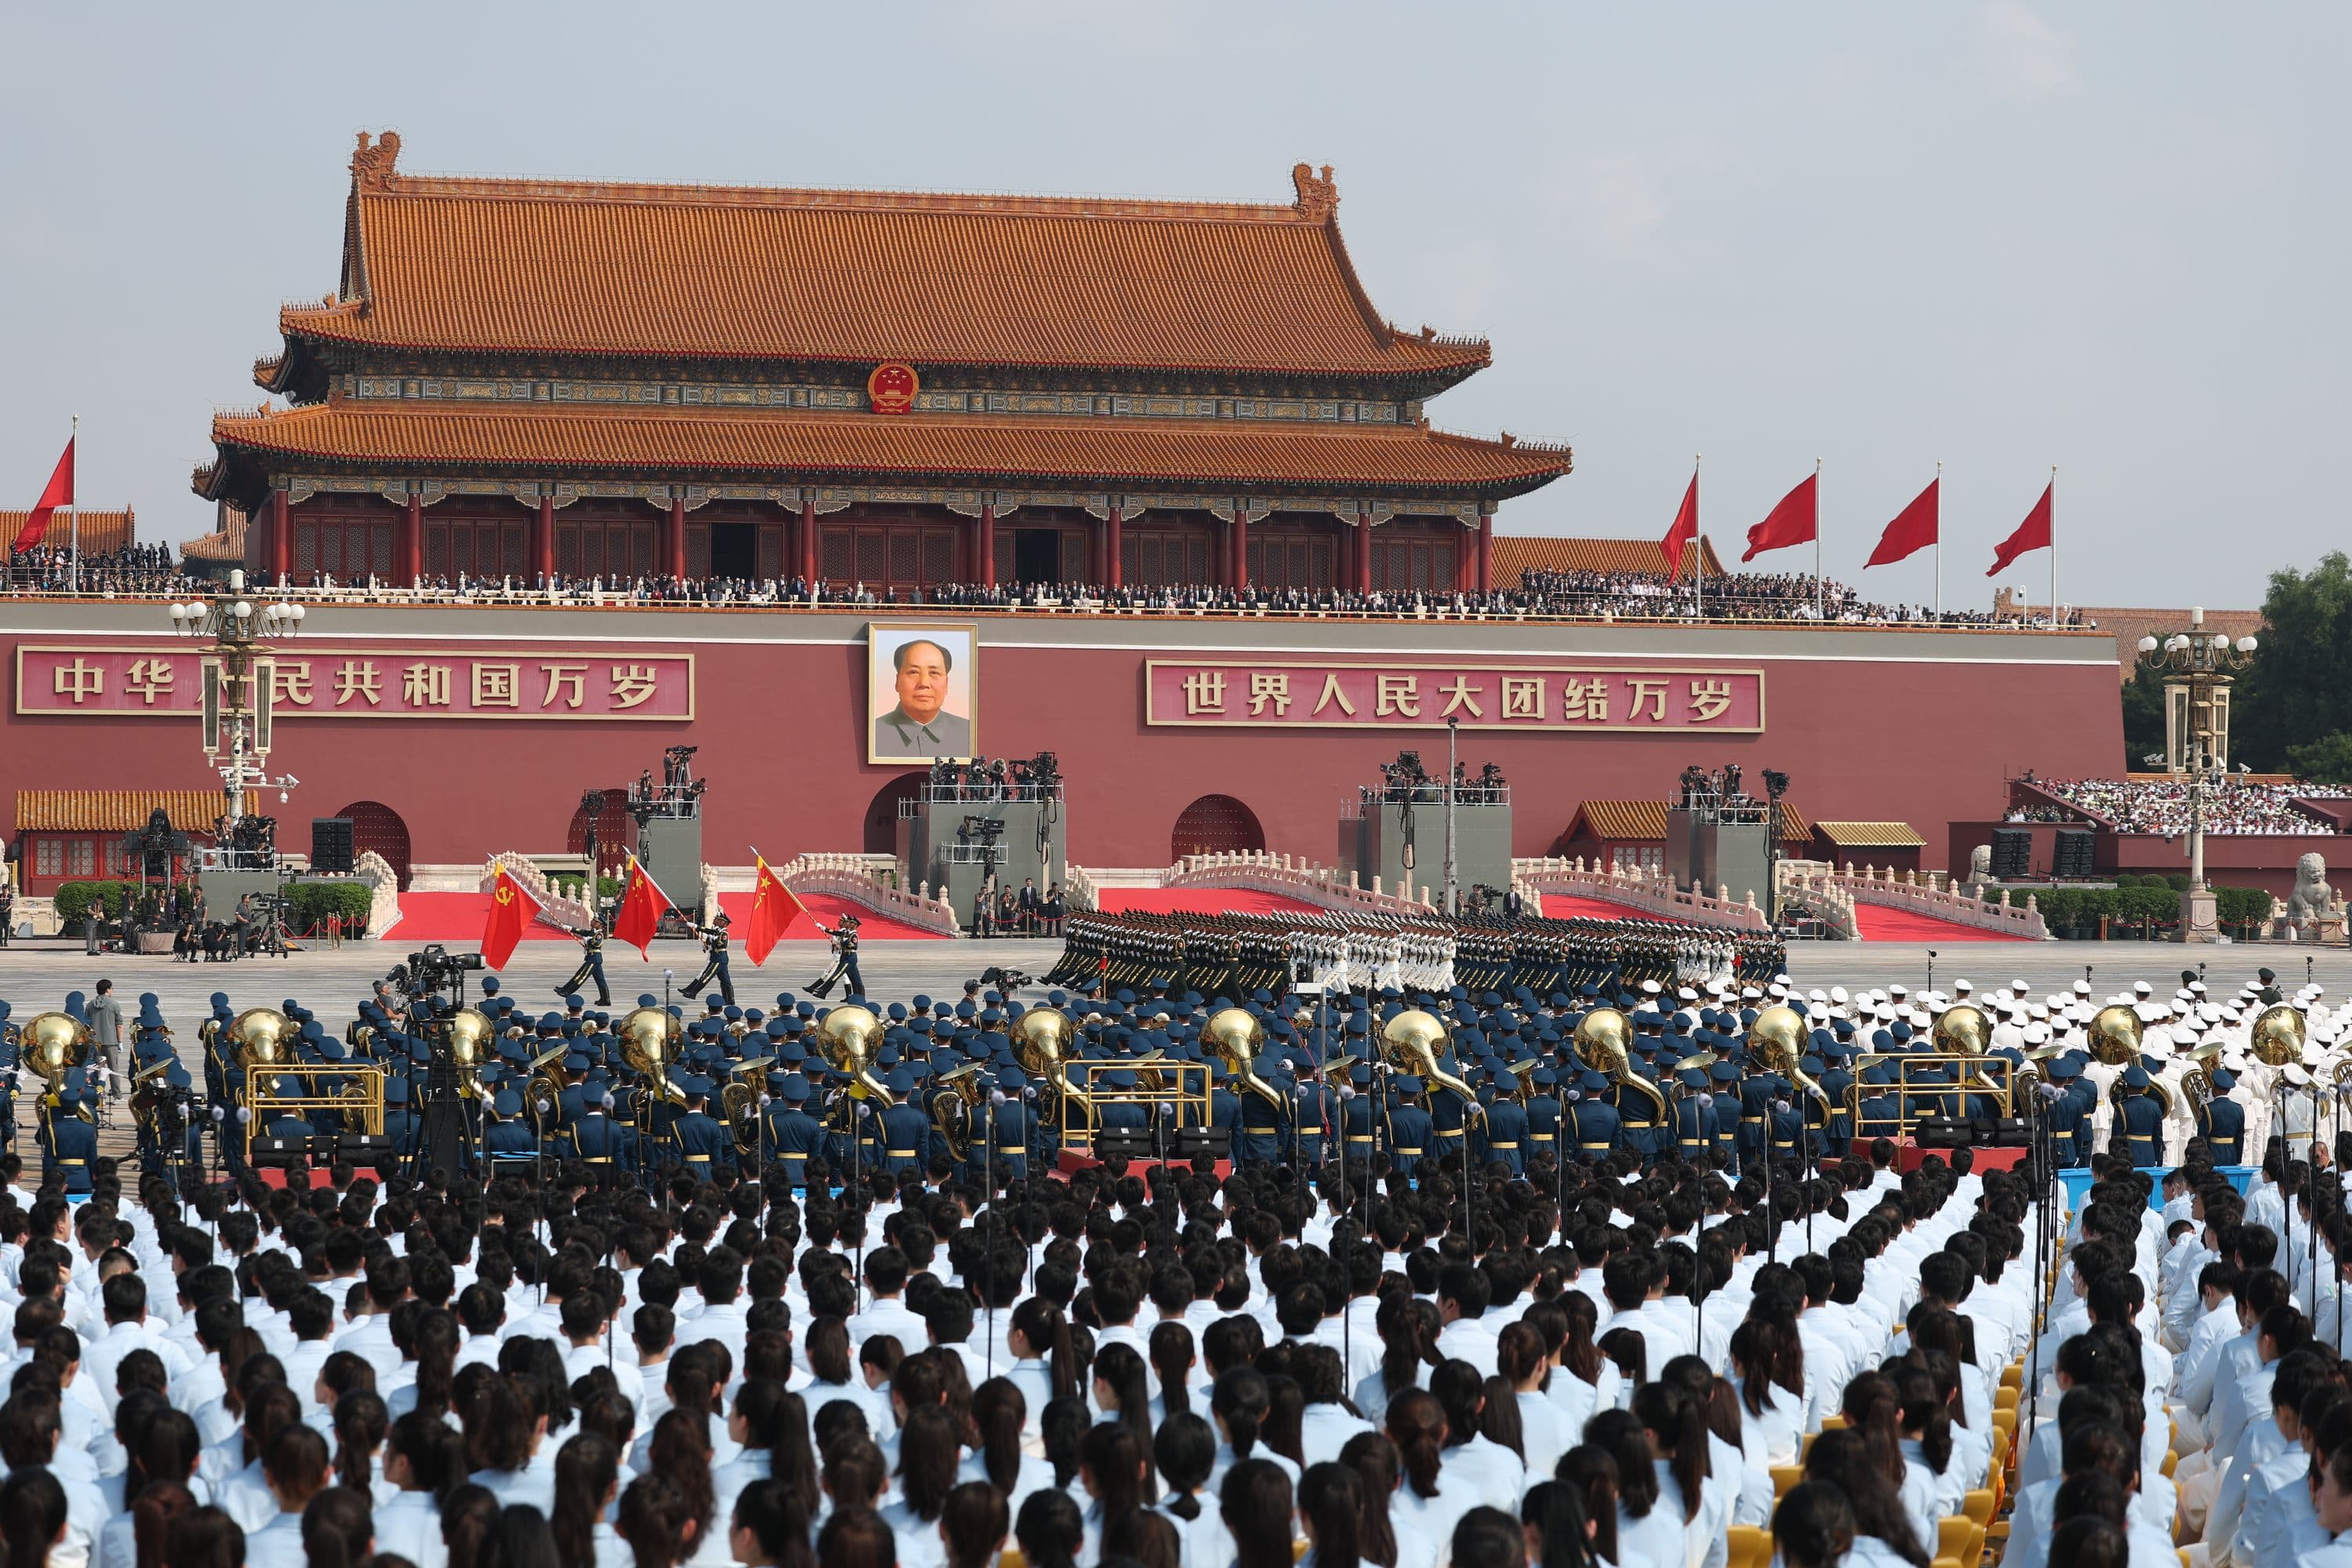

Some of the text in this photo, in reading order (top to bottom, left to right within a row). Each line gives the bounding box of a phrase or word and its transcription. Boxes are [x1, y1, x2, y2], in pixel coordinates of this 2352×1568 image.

[54, 659, 657, 709] 中华民共和国万岁
[1181, 672, 1732, 722] 世界人民大团结万岁
